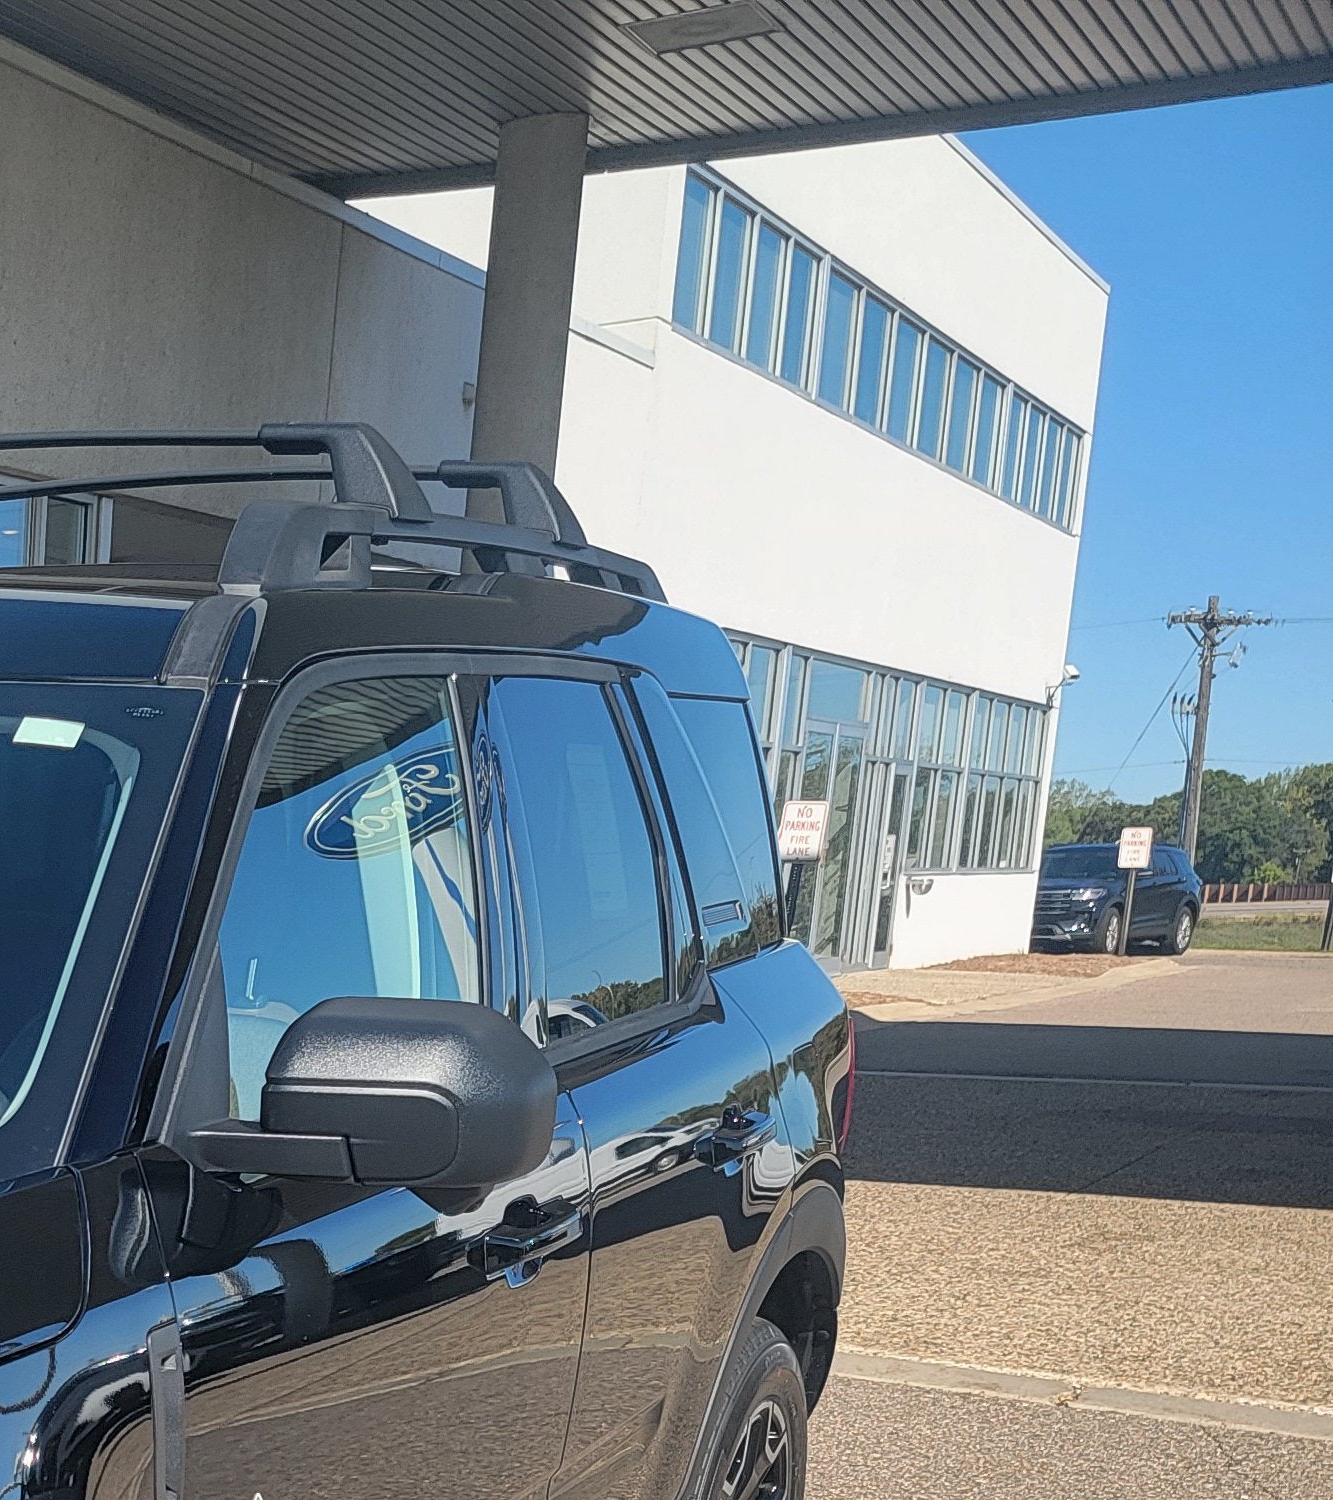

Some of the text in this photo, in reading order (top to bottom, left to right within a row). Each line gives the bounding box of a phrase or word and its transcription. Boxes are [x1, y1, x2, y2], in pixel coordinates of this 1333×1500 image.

[797, 807, 813, 818] NO
[785, 820, 821, 832] PARKING
[790, 835, 811, 845] FIRE
[786, 847, 811, 857] LANE
